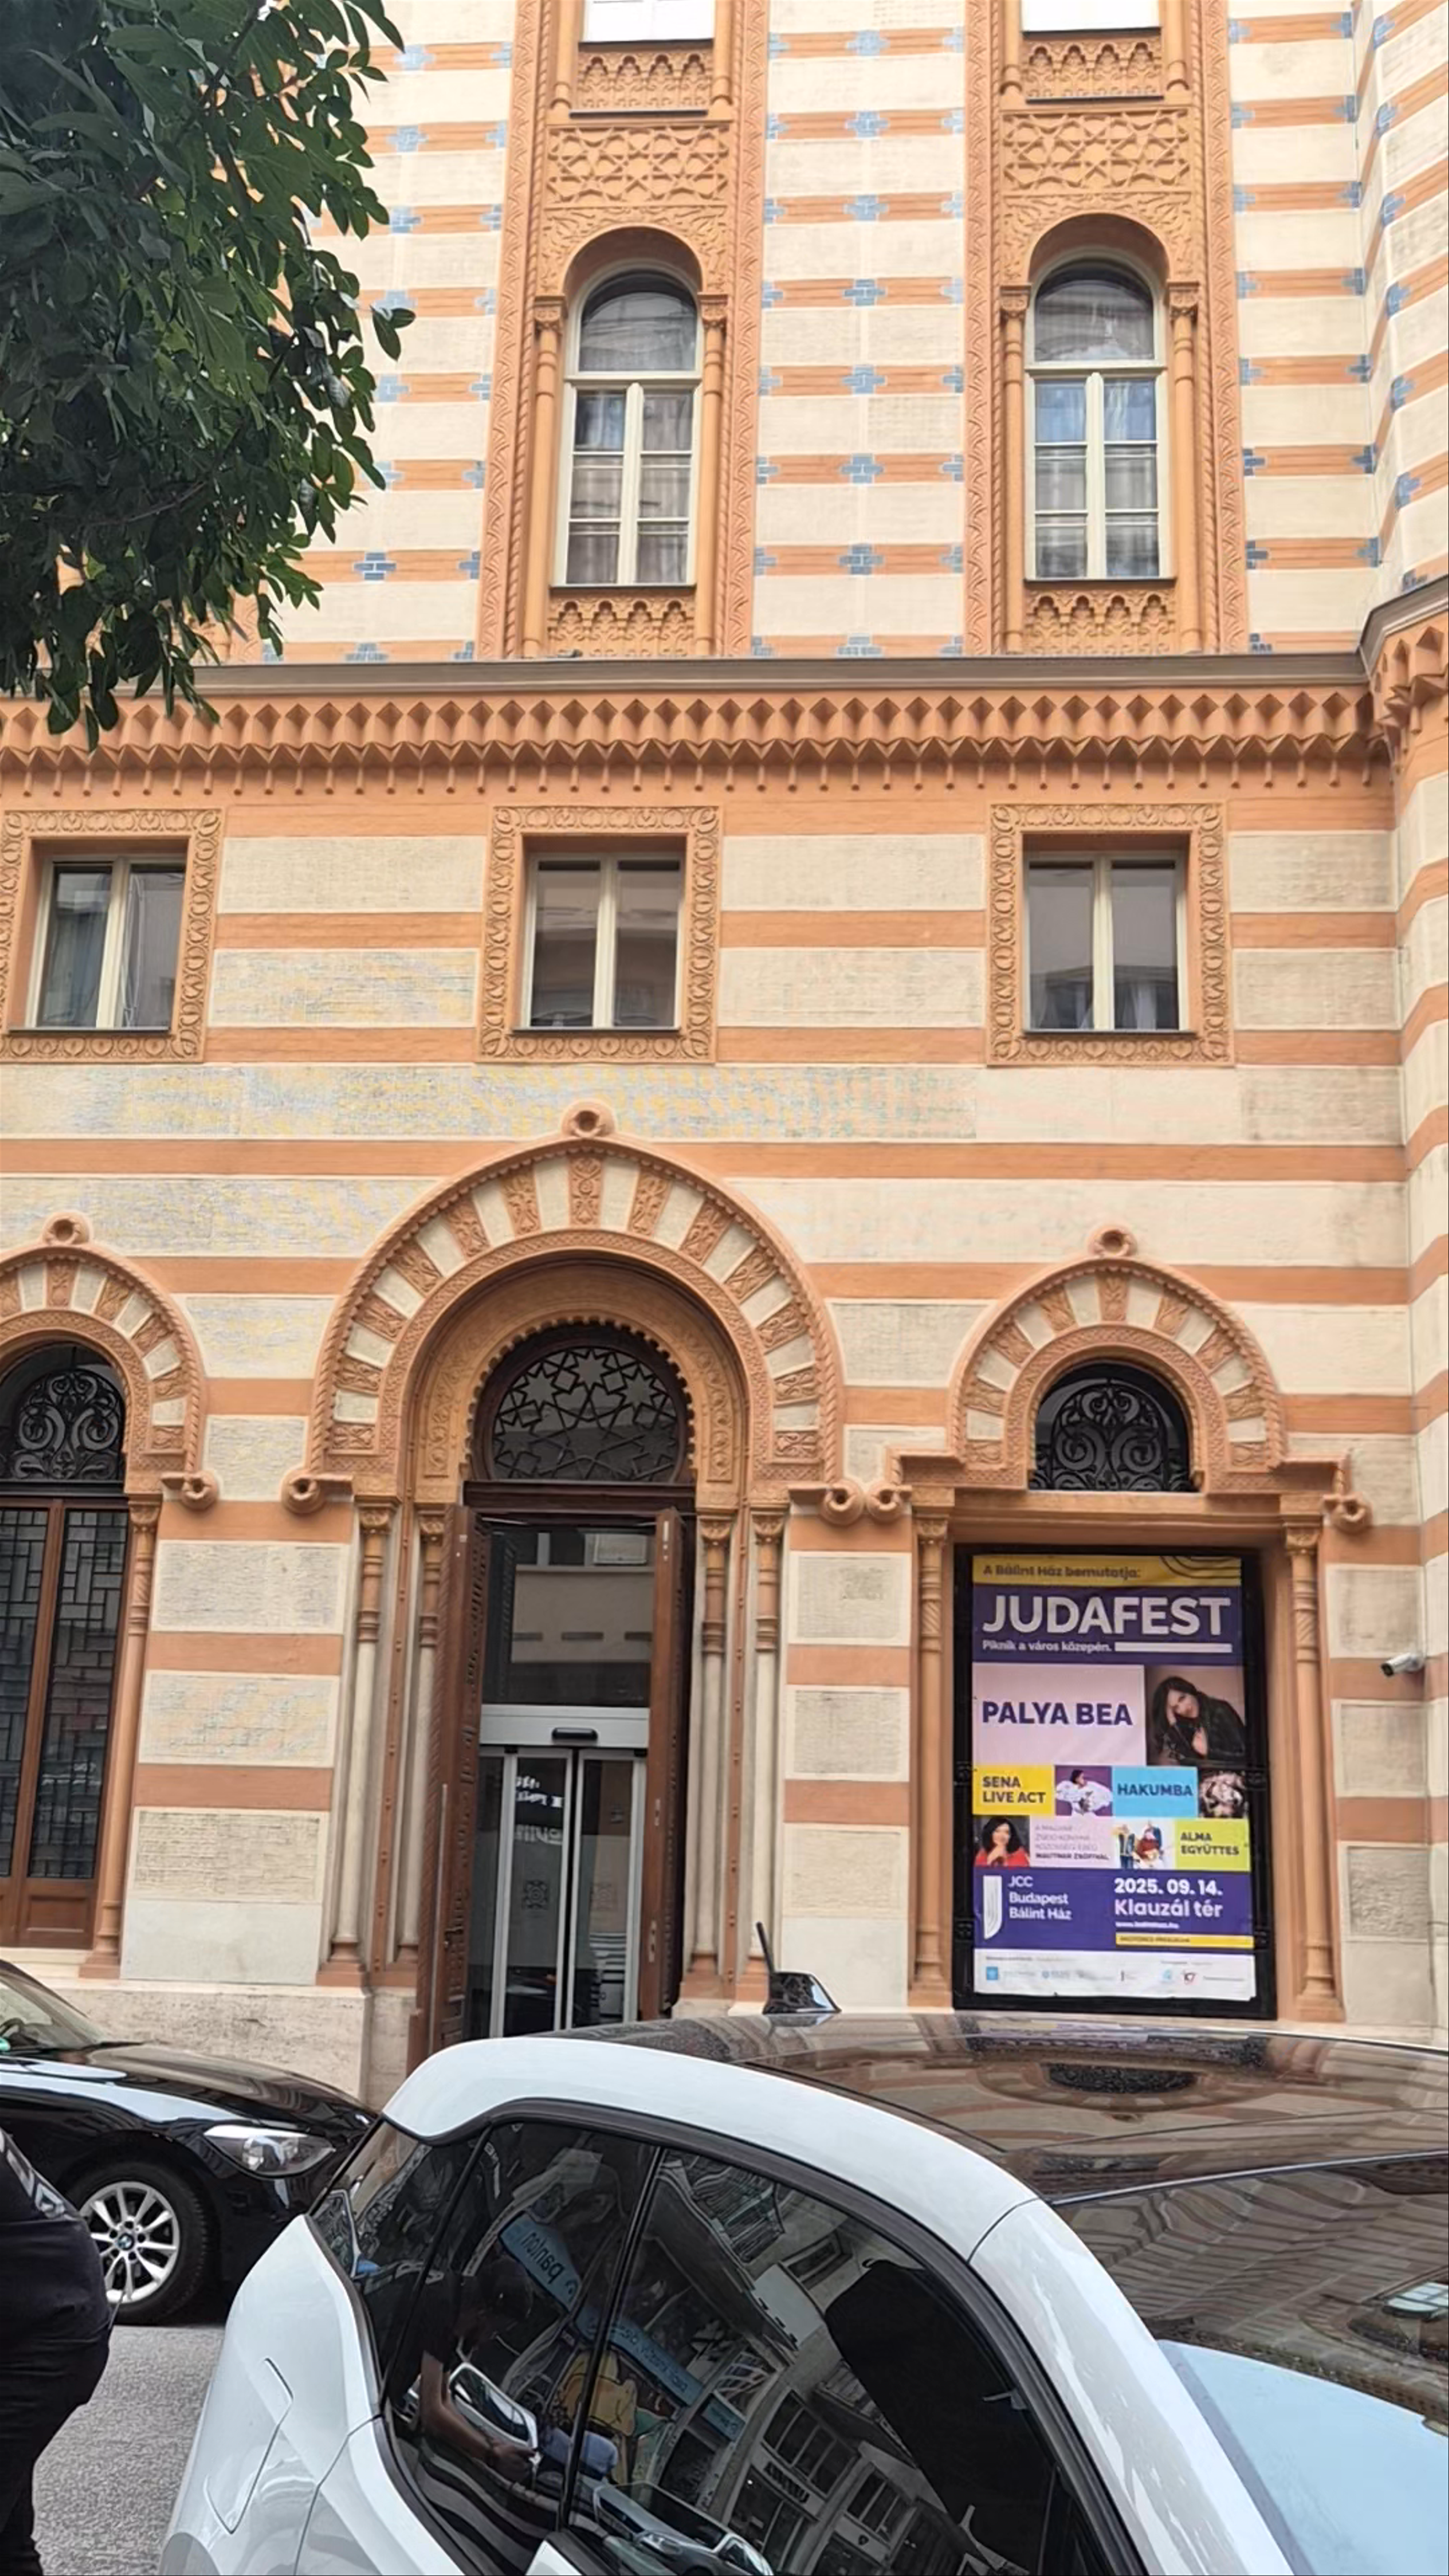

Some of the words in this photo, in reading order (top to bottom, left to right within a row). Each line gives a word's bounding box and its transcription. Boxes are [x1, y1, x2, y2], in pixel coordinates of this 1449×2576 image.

[983, 1566, 992, 1575] A
[1038, 1565, 1062, 1576] Ház
[1065, 1566, 1140, 1580] bemutatja:
[983, 1595, 1231, 1635] JUDAFEST
[983, 1640, 1016, 1650] Piknik
[1029, 1641, 1059, 1651] város
[1062, 1641, 1112, 1653] közepén.
[983, 1701, 1069, 1724] PALYA
[1076, 1703, 1133, 1726] BEA
[983, 1776, 1021, 1788] SENA
[1117, 1782, 1193, 1796] HAKUMBA
[983, 1791, 1014, 1803] LIVE
[1018, 1792, 1046, 1803] ACT
[1181, 1832, 1212, 1841] ALMA
[1181, 1844, 1240, 1856] EGYÜTTES
[1008, 1875, 1033, 1887] JCC
[1114, 1878, 1164, 1894] 2025.
[1167, 1879, 1196, 1895] 09.
[1198, 1879, 1223, 1895] 14.
[1009, 1891, 1069, 1906] Budapest
[1009, 1906, 1045, 1920] Bálint
[1048, 1908, 1073, 1920] Ház
[1115, 1898, 1190, 1916] Klauzál
[1193, 1899, 1223, 1917] tér
